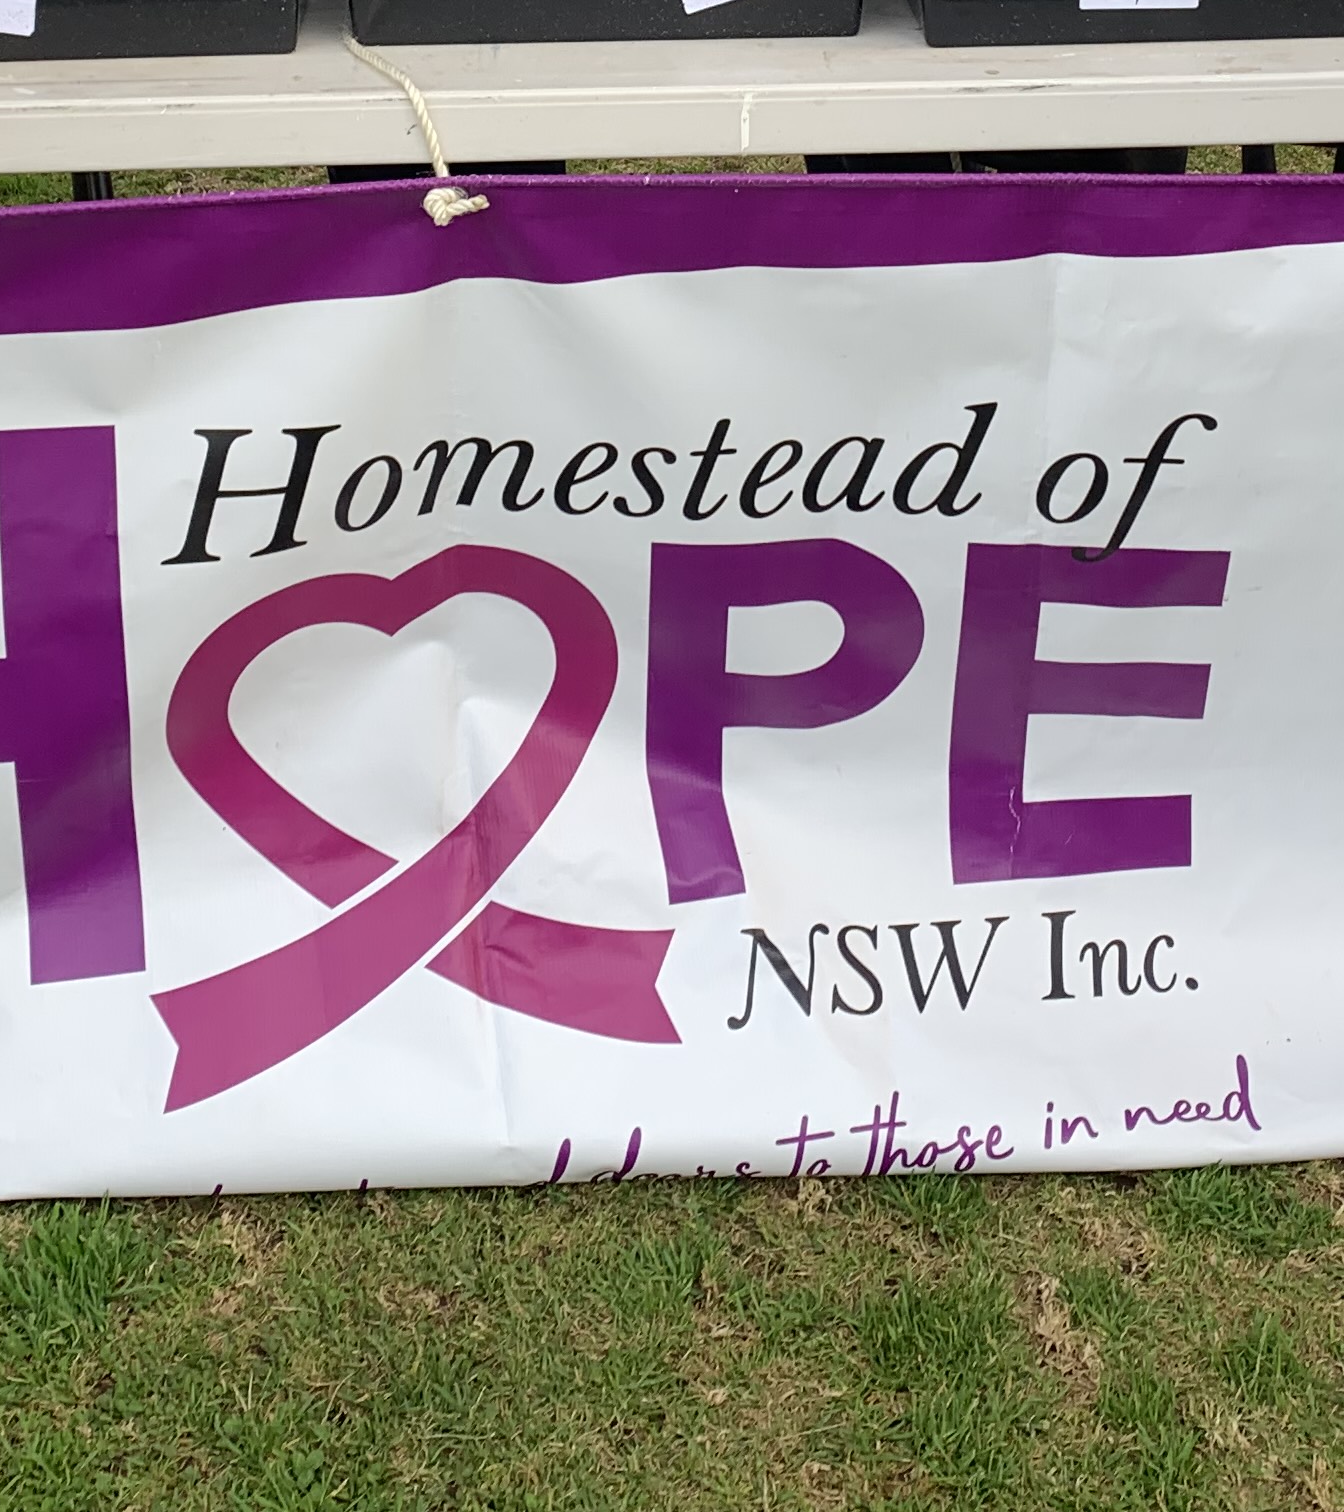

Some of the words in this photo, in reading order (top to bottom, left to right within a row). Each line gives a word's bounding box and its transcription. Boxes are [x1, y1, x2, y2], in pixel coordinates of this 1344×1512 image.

[160, 402, 998, 565] Homestead
[1036, 413, 1219, 564] of
[726, 915, 1011, 1031] NSW
[1041, 910, 1200, 1001] Inc.
[775, 1115, 833, 1177] to
[849, 1091, 1014, 1175] those
[1043, 1101, 1097, 1149] in
[1124, 1054, 1261, 1131] need
